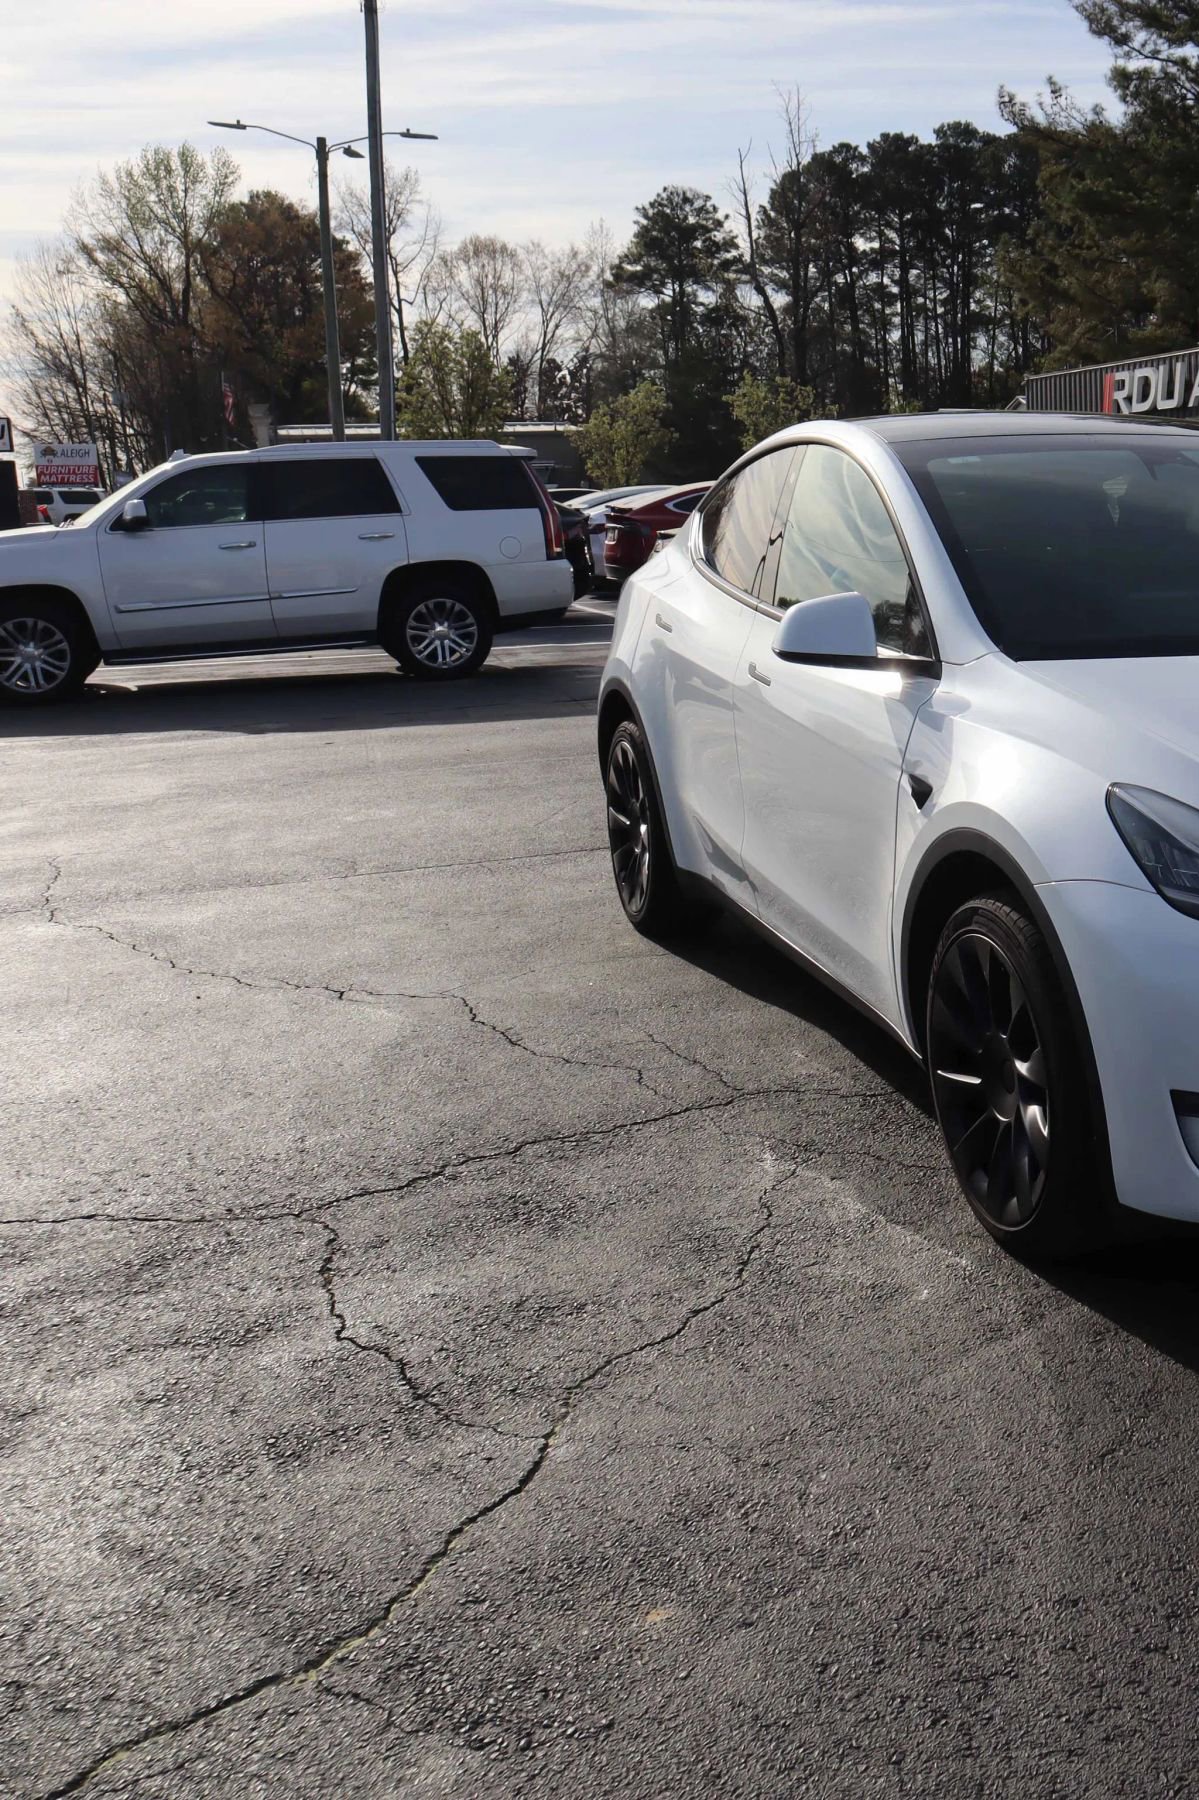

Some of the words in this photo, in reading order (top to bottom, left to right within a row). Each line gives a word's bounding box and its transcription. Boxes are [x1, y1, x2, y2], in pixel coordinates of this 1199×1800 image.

[1112, 360, 1190, 414] RDU
[37, 465, 96, 474] FURNITURE
[40, 474, 95, 482] MATTRESS
